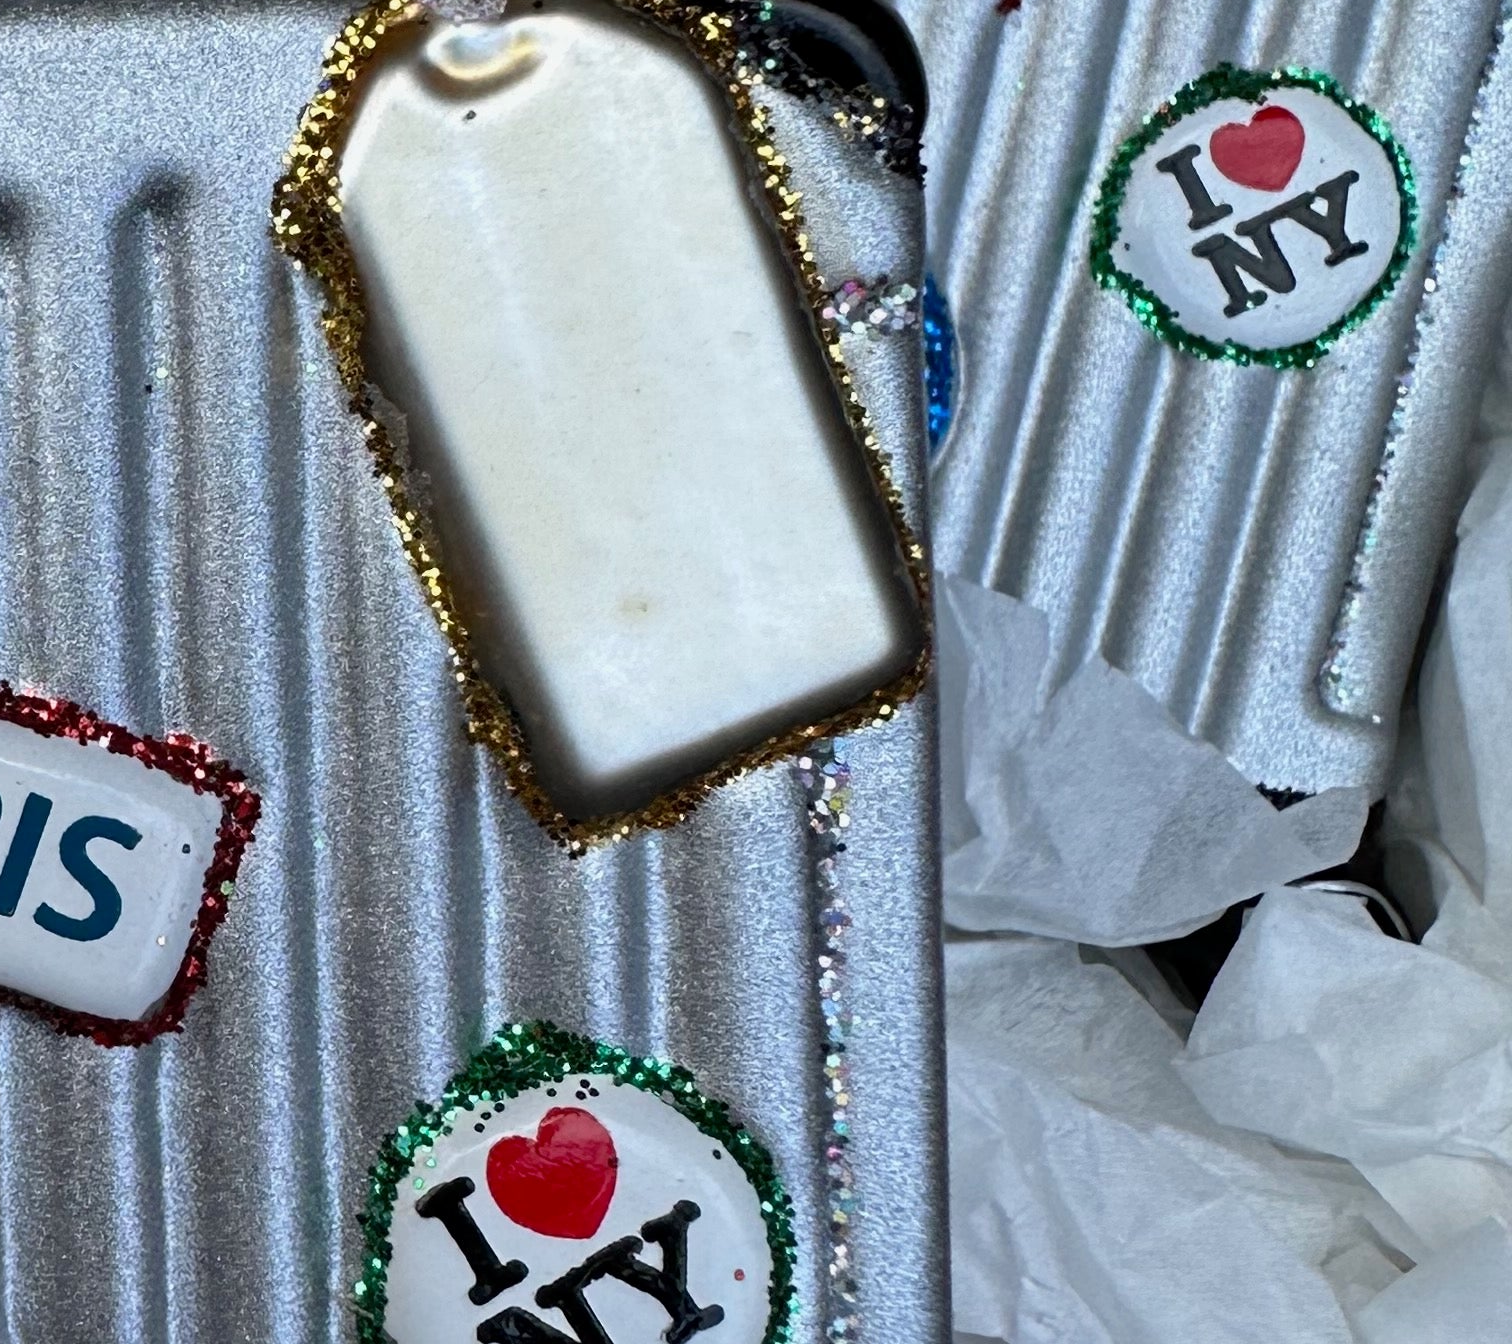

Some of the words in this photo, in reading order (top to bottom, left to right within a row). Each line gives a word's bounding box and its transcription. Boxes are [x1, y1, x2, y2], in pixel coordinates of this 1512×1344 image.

[1155, 144, 1233, 231] I
[1191, 169, 1369, 318] NY
[415, 1176, 529, 1306] I
